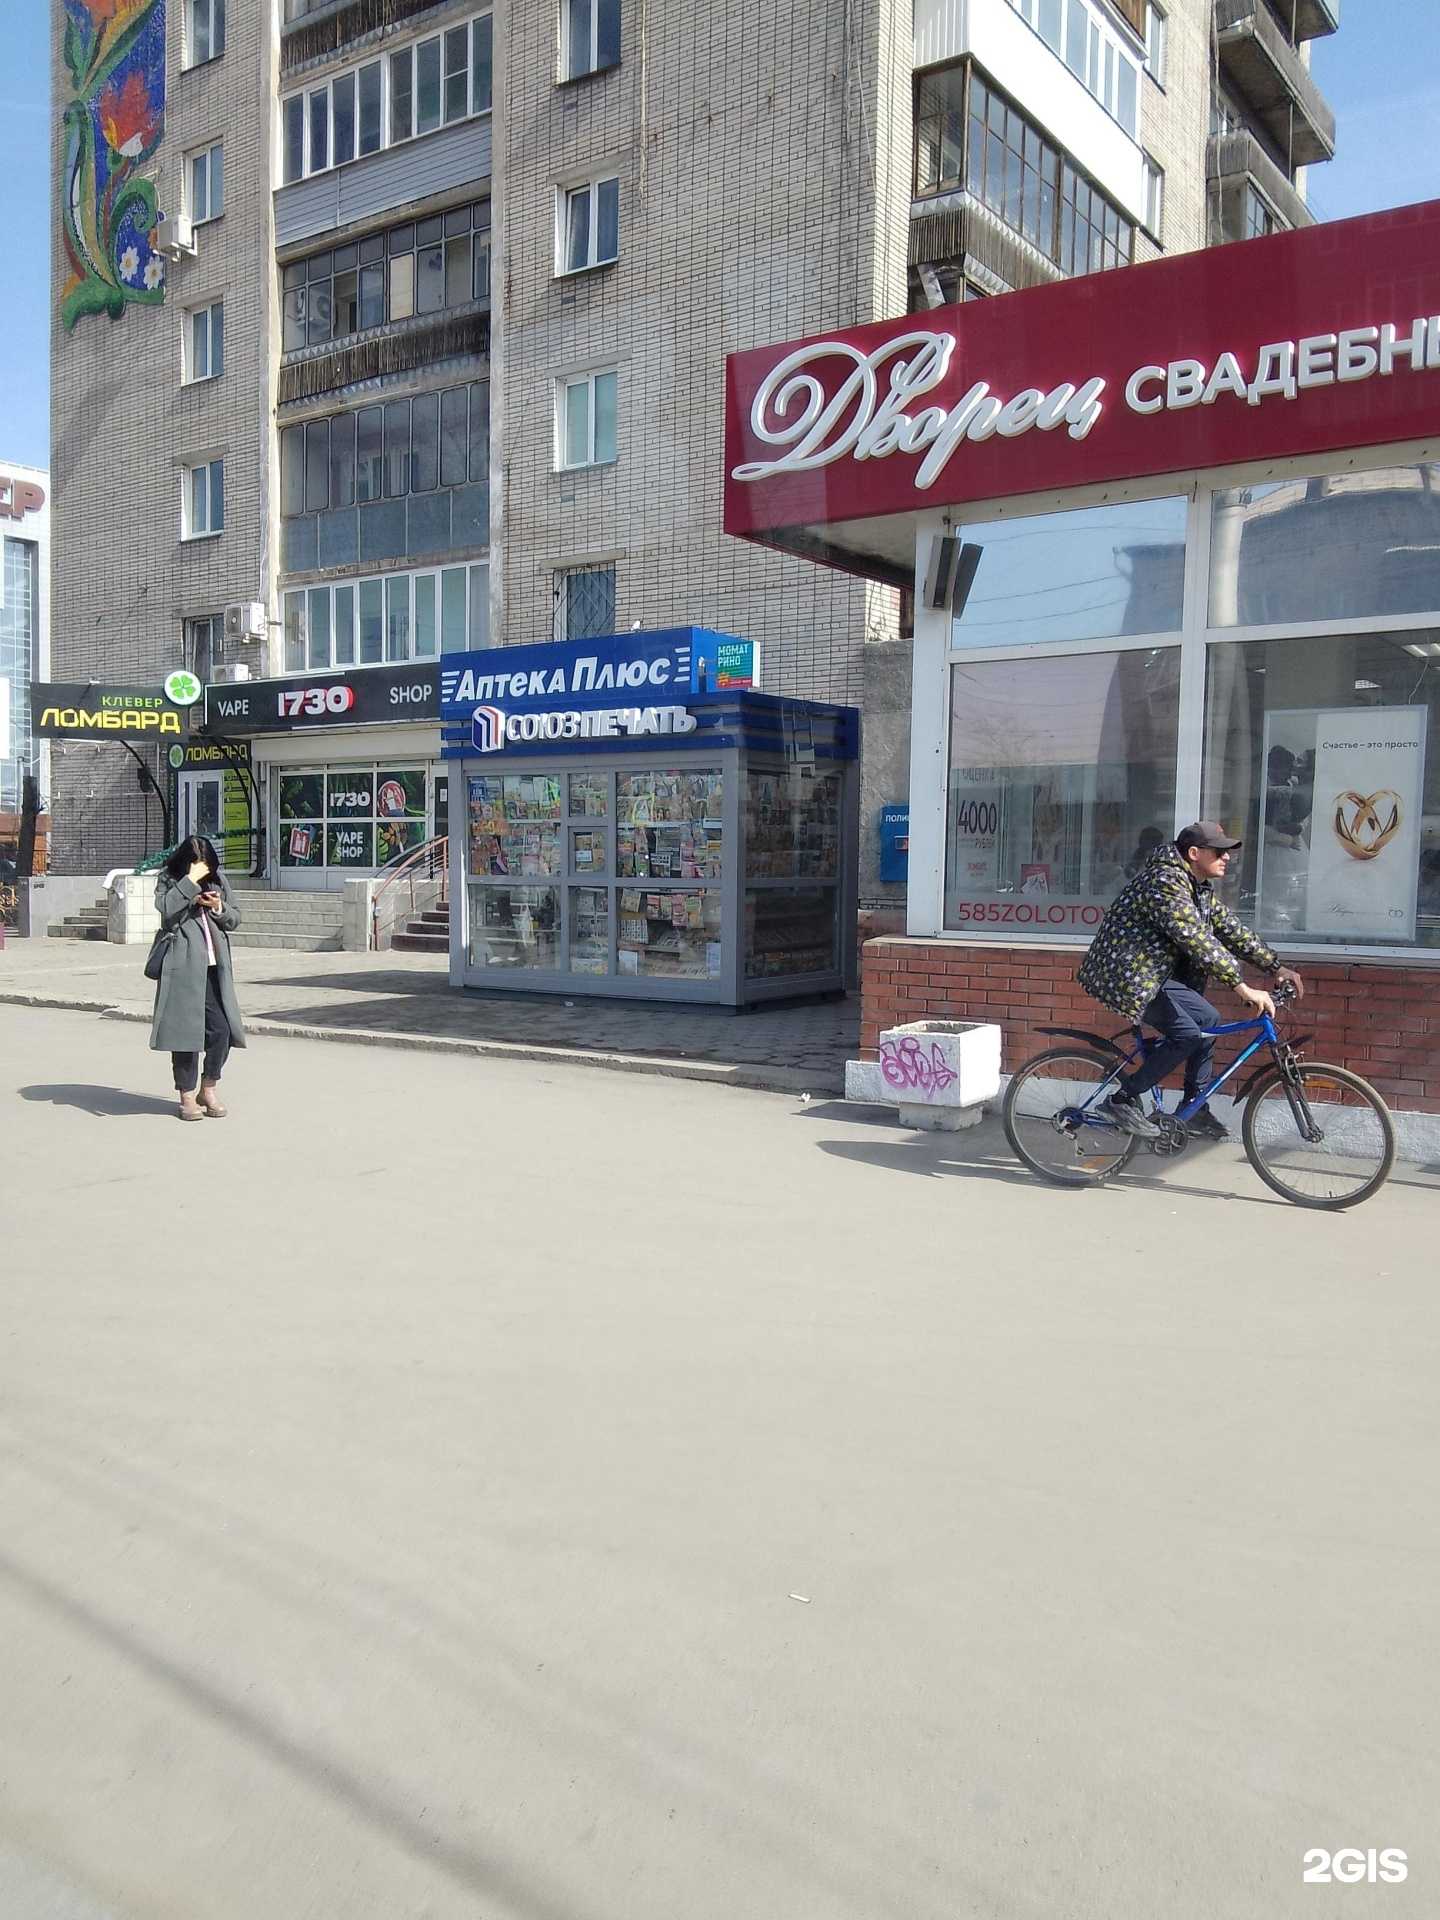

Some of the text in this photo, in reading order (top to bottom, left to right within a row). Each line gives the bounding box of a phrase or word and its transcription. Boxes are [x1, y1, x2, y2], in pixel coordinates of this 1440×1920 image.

[731, 314, 1440, 490] Дворец СВАДЕБН
[717, 655, 741, 667] РИНО
[102, 696, 163, 708] КЛЕВЕР
[218, 684, 432, 718] VAPE 1730 SHOP
[40, 708, 181, 735] ЛОМБАРД
[506, 705, 697, 742] СОЮЗПЕЧАТЬ
[1322, 741, 1359, 749] Счастье
[1384, 741, 1418, 750] просто
[329, 791, 371, 808] 1730
[957, 800, 998, 834] 4000
[336, 831, 364, 845] VAPE
[336, 846, 364, 859] SHOP
[958, 903, 1104, 925] 585ZOLOTO
